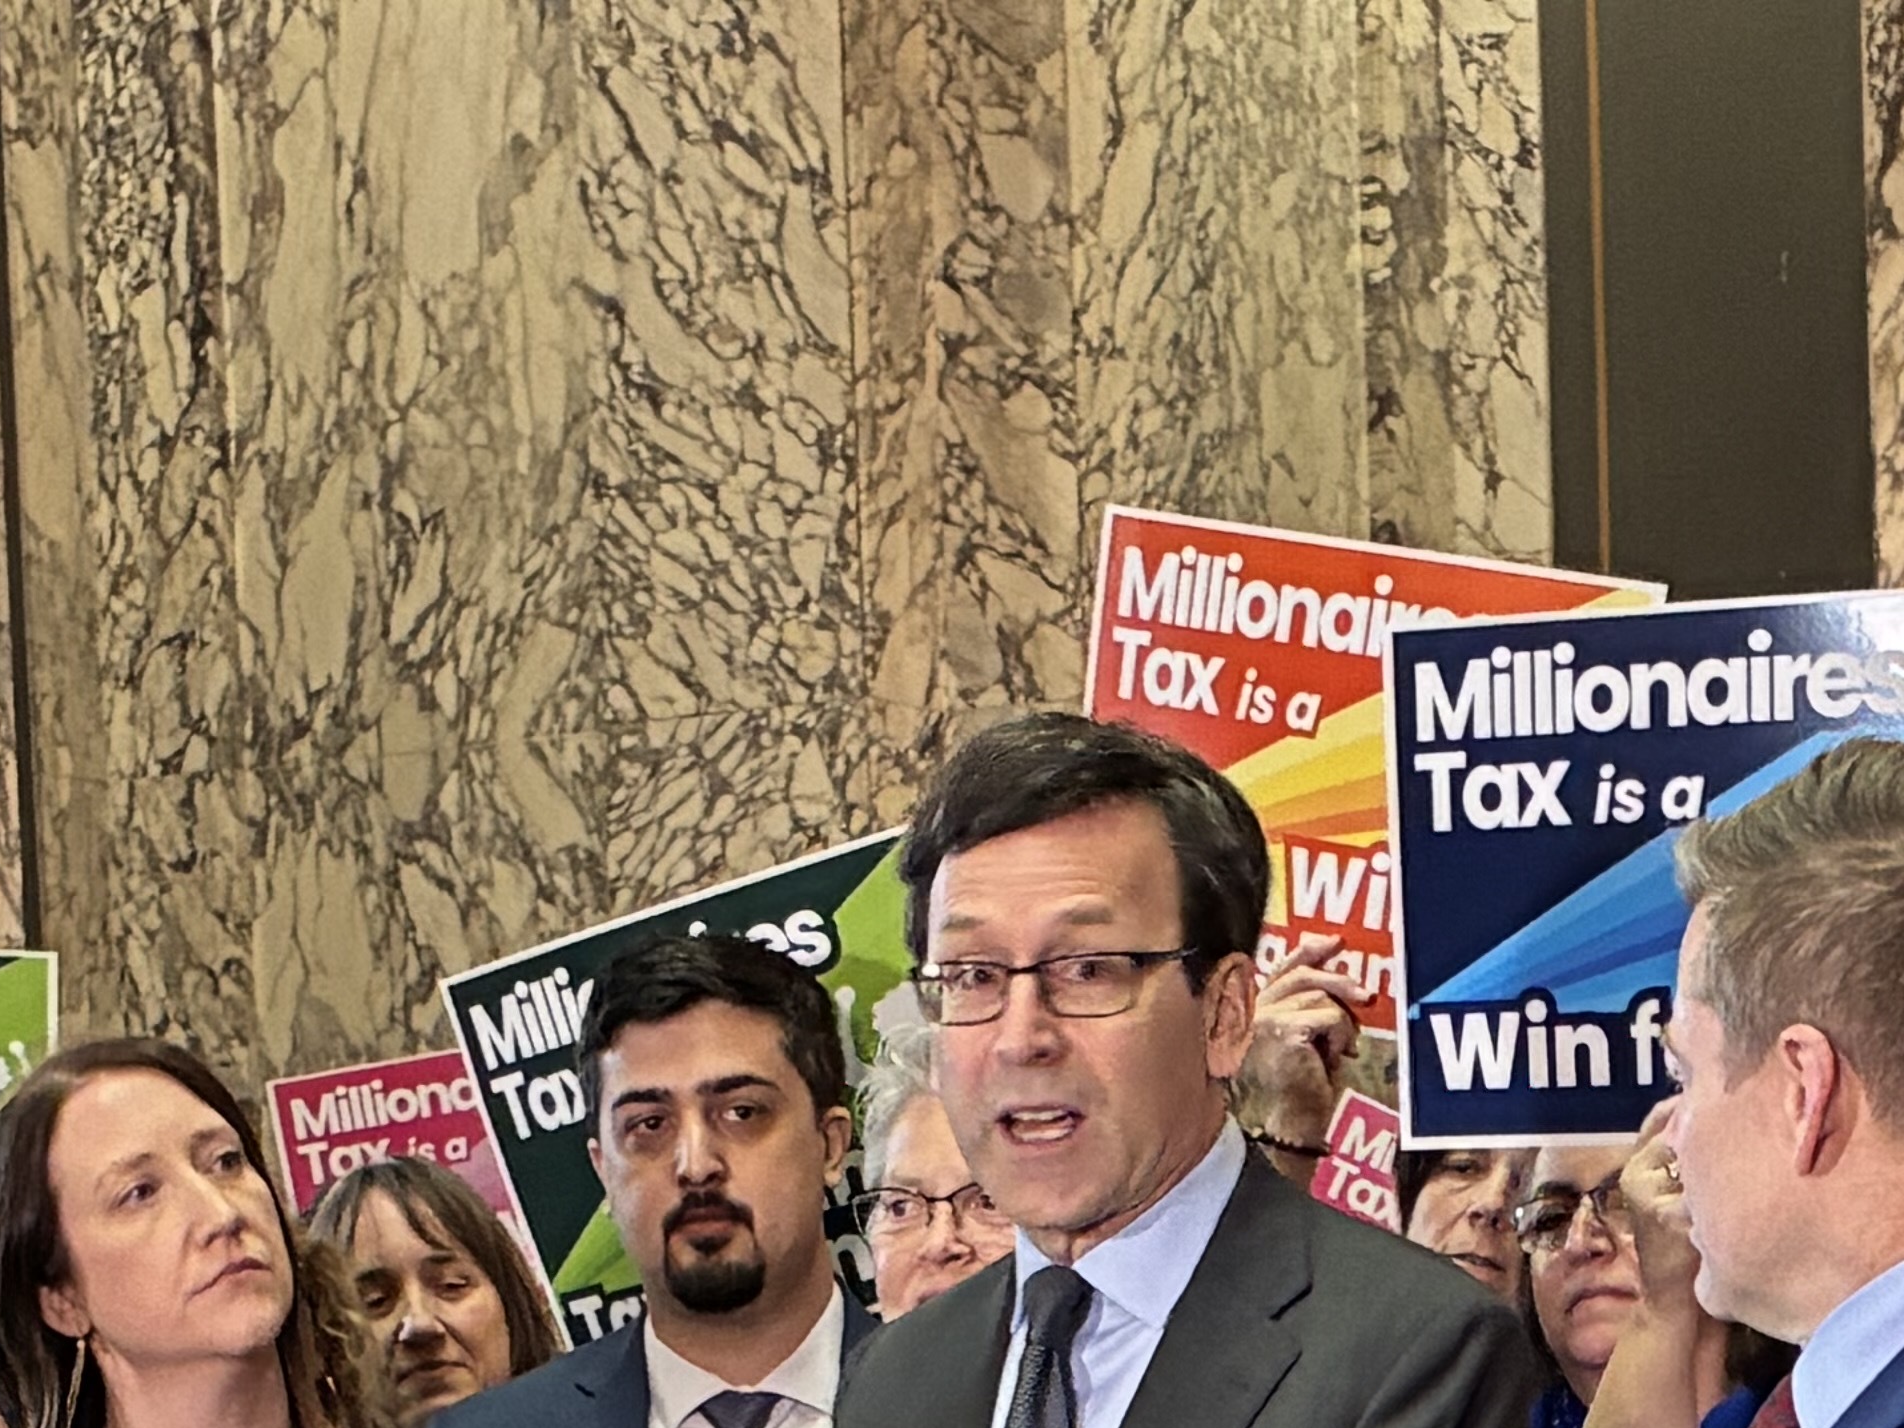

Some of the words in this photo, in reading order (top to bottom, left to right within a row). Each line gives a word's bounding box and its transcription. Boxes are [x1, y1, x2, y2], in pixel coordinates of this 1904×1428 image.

[1112, 627, 1225, 717] Tax
[1235, 667, 1275, 726] is
[1286, 692, 1322, 731] a
[1413, 751, 1571, 833] Tax
[1593, 764, 1645, 826] is
[1661, 774, 1705, 820] a
[1291, 845, 1395, 932] Wi
[1429, 998, 1611, 1090] Win
[407, 1136, 437, 1163] is
[444, 1136, 468, 1162] a
